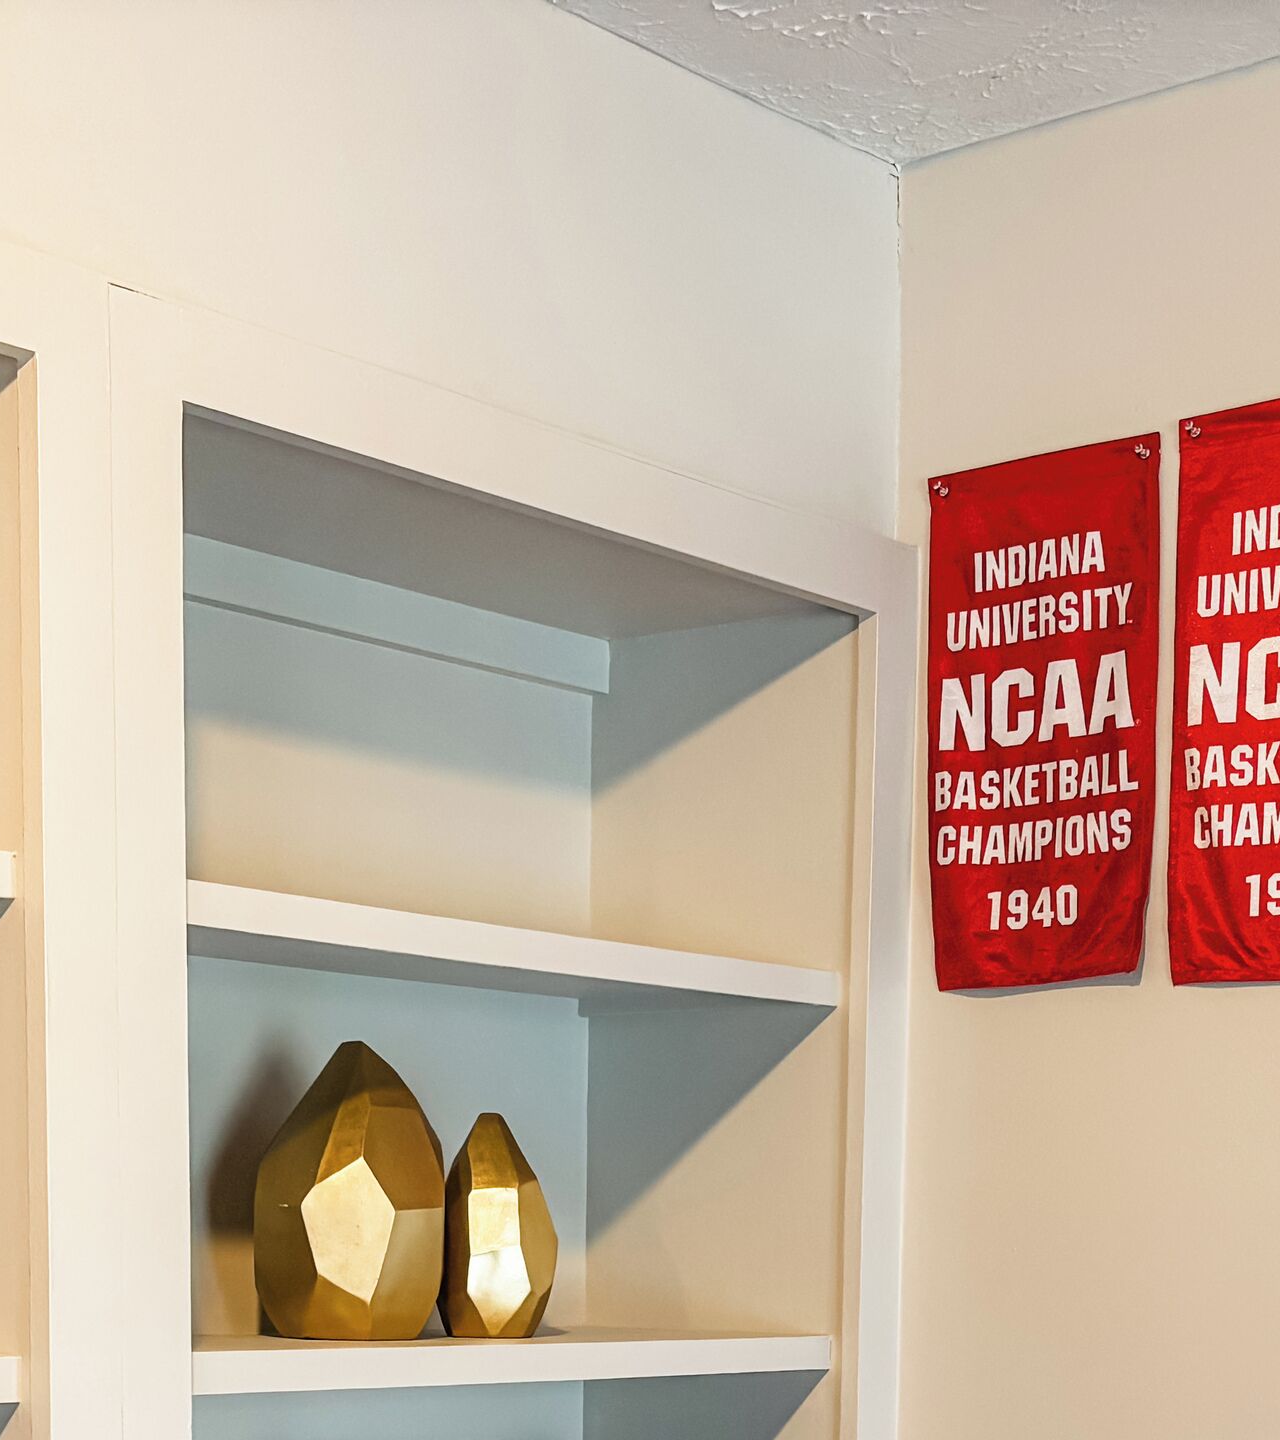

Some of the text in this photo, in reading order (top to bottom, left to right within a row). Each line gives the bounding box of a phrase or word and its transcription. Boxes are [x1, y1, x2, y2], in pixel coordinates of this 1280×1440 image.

[974, 531, 1106, 592] INDIANA
[946, 582, 1133, 652] UNIVERSITY
[938, 650, 1134, 752] NCAA
[934, 750, 1139, 812] BASKETBALL
[936, 808, 1132, 866] CHAMPIONS
[986, 884, 1078, 931] 1940
